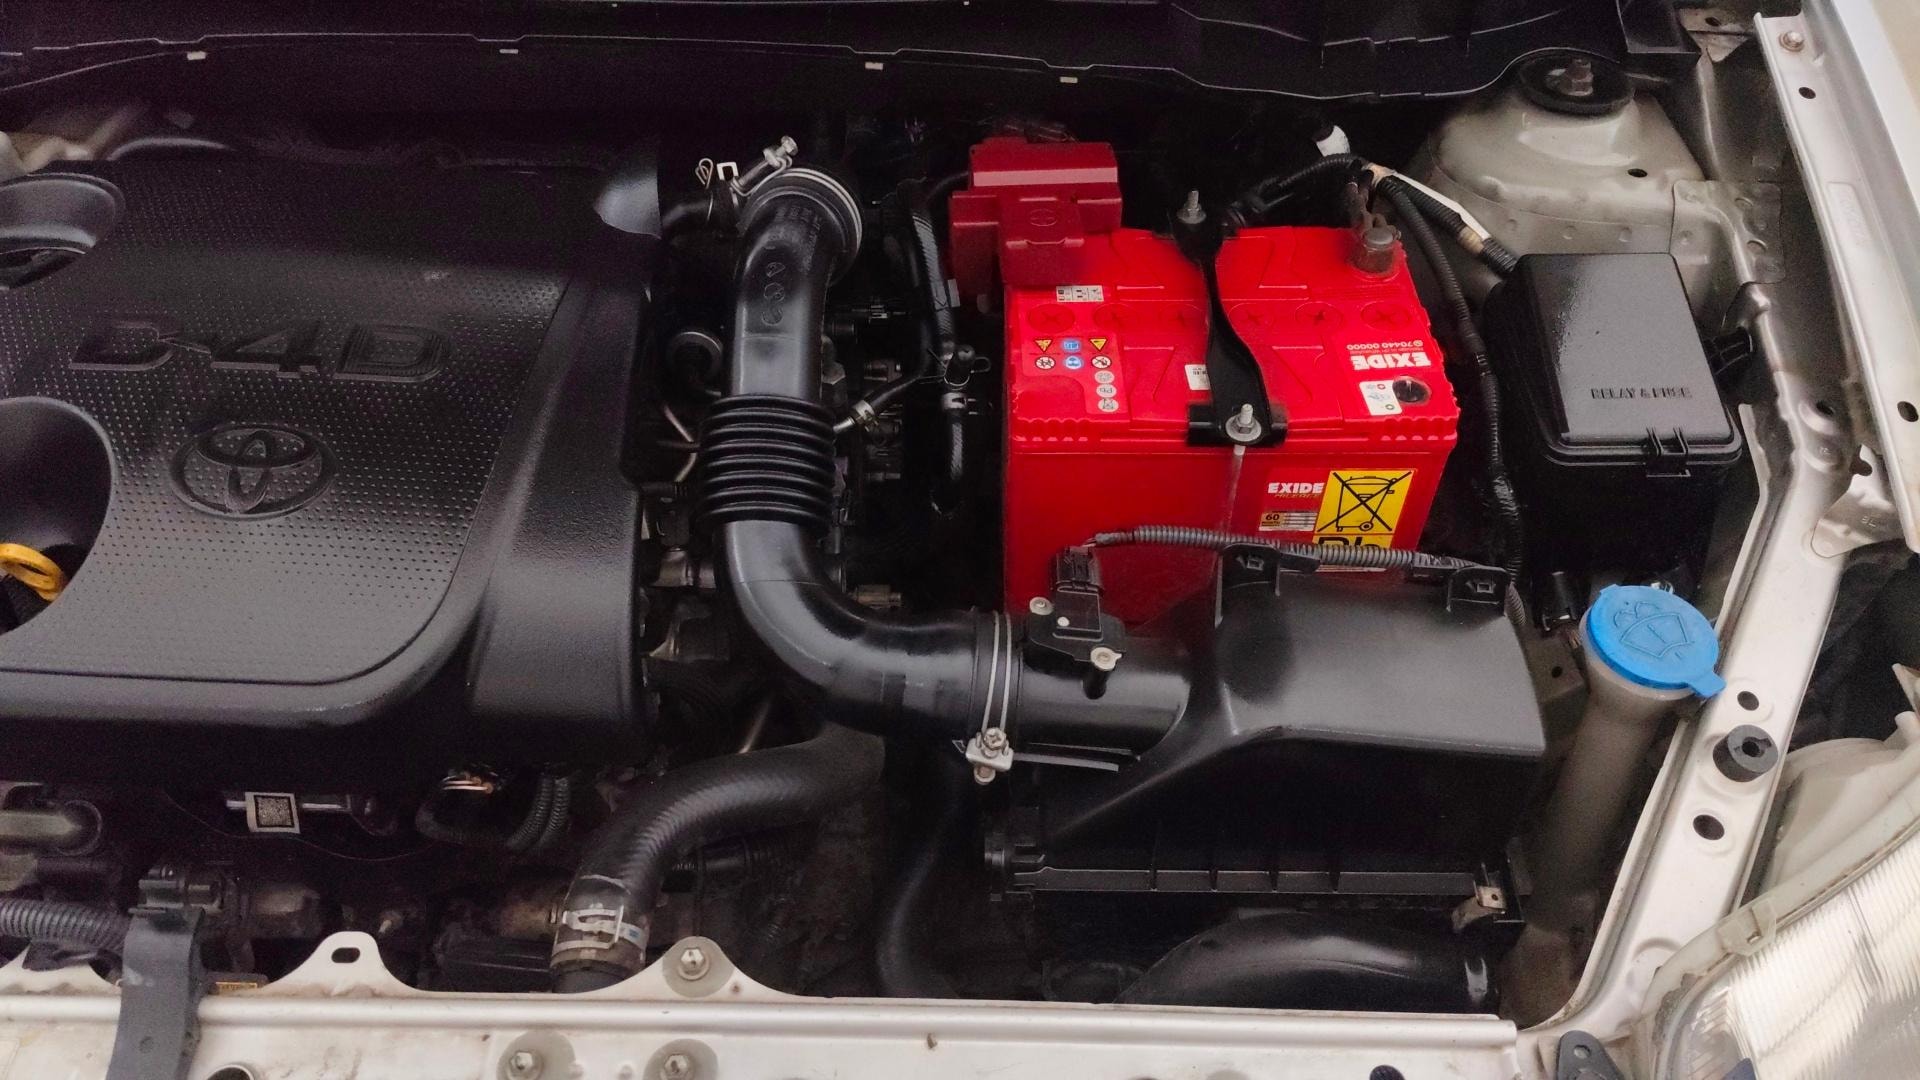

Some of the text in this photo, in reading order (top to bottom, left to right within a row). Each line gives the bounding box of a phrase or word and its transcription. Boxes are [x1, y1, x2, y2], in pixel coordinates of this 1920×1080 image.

[69, 316, 450, 384] D-4D
[1351, 351, 1431, 370] EXIDE
[1590, 387, 1693, 399] RELAY & FUSE
[1267, 482, 1325, 494] EXIDE
[1265, 513, 1280, 521] 60
